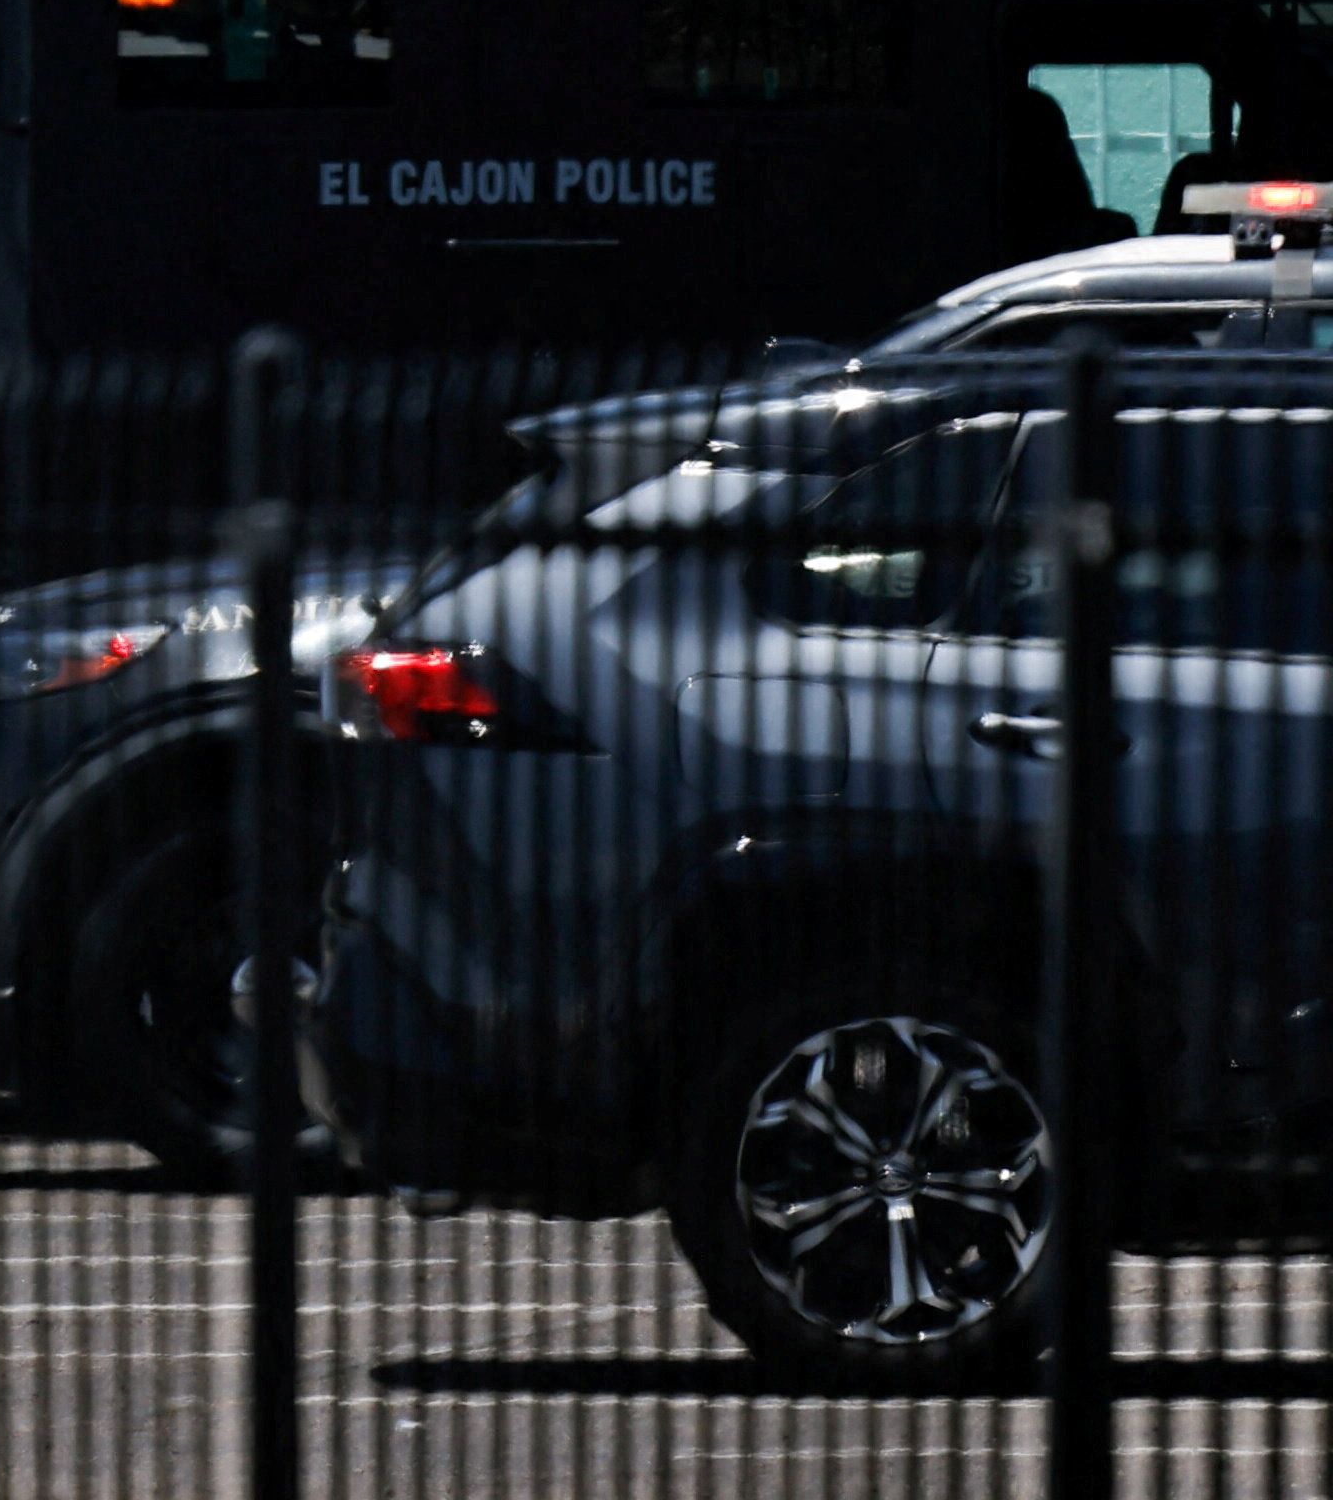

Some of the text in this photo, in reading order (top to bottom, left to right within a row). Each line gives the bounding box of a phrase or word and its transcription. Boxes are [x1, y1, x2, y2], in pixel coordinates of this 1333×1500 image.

[319, 158, 716, 205] EL CAJON POLICE
